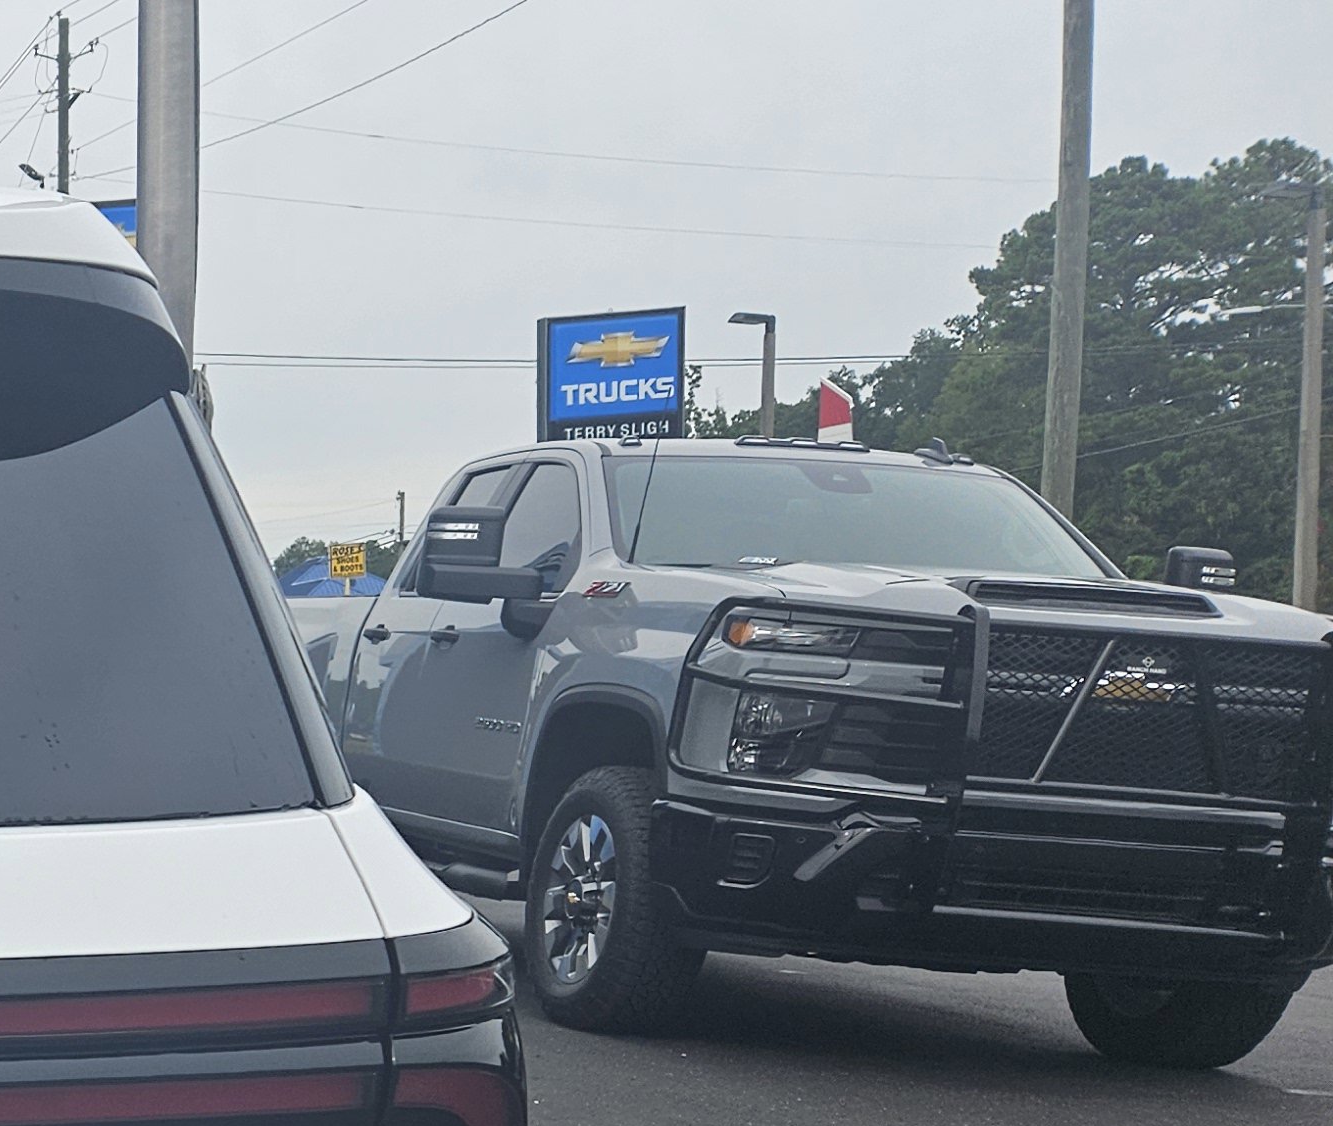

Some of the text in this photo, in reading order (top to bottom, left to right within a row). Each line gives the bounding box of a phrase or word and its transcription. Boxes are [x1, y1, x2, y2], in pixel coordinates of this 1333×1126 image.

[560, 376, 675, 406] TRUCKS
[564, 420, 669, 440] TERRY SLIGH
